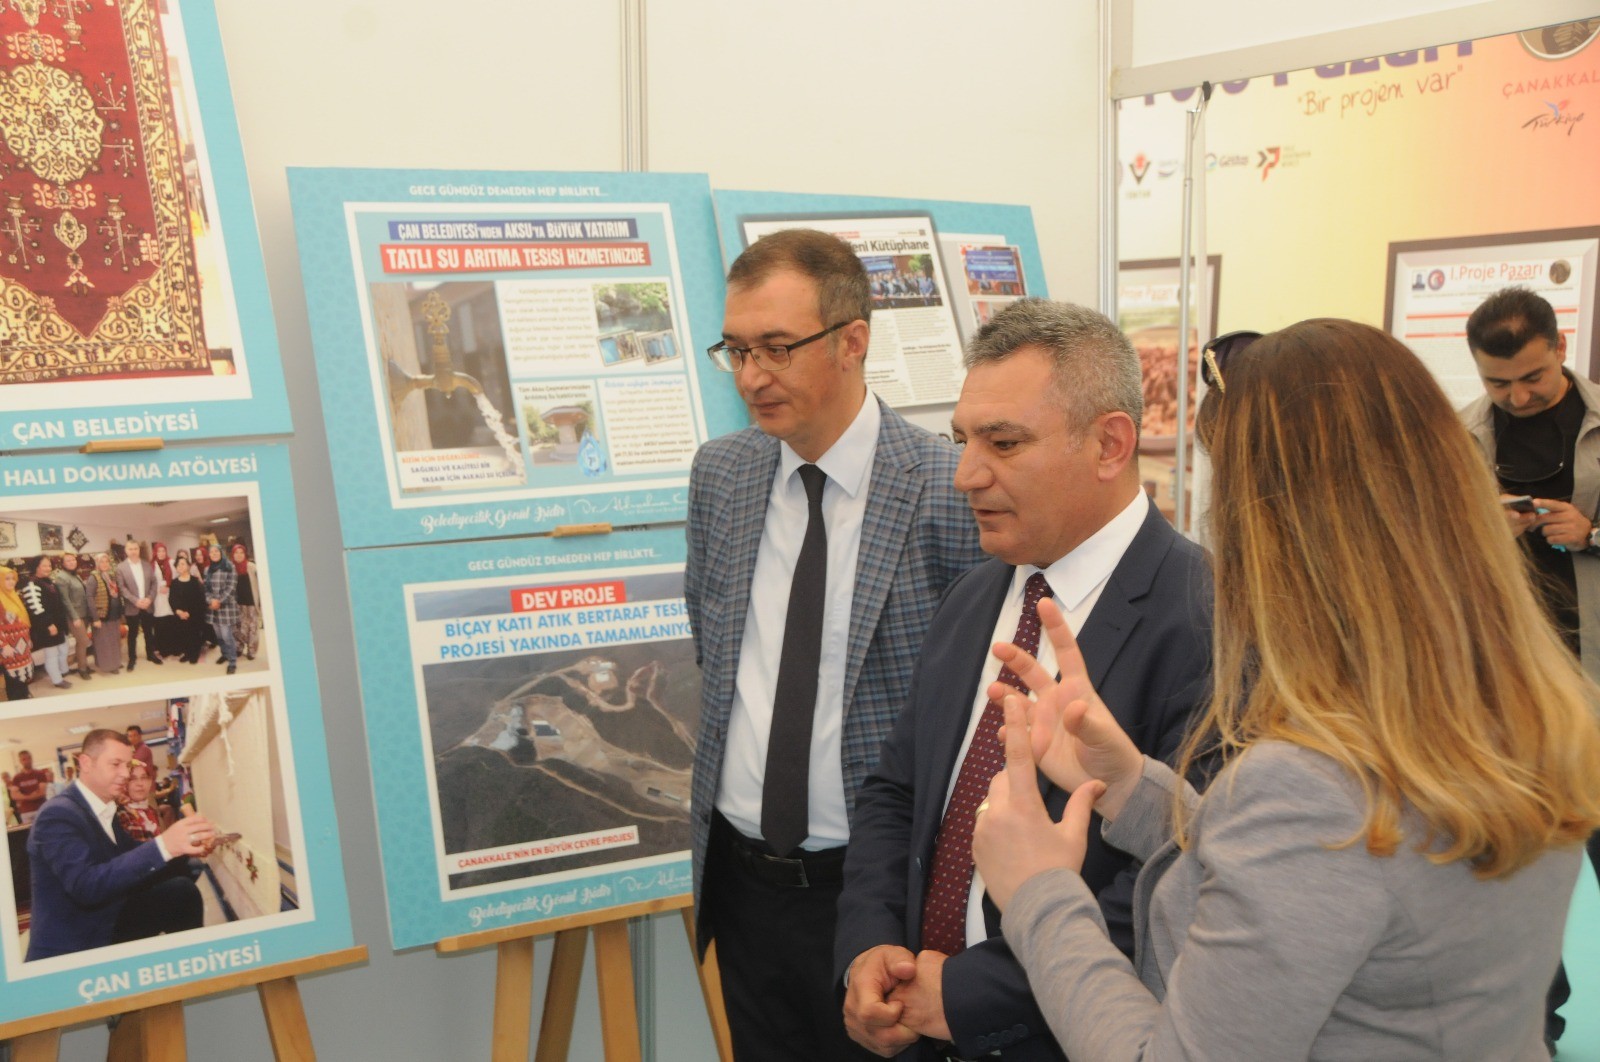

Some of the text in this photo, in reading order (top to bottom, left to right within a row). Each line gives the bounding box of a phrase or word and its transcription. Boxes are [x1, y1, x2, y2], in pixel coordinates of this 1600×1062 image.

[1341, 81, 1404, 118] projem
[410, 185, 436, 196] GECE
[439, 185, 485, 196] GÜNDÜZ
[488, 186, 535, 196] DEMEDEN
[538, 186, 557, 196] HEP
[398, 224, 420, 241] ÇAN
[547, 222, 583, 239] BÜYÜK
[584, 222, 630, 238] YATIRIM
[387, 246, 646, 270] TATLI SU ARITMA TESİSİ HİZMETİNİZDE
[871, 240, 929, 253] Kütüphane
[1500, 263, 1543, 279] Pazarı
[12, 408, 199, 445] ÇAN BELEDİYESİ
[4, 453, 258, 487] HALI DOKUMA ATÖLYESİ
[442, 463, 451, 471] VE
[468, 559, 495, 572] GECE
[497, 556, 542, 570] GÜNDÜZ
[545, 552, 592, 566] DEMEDEN
[594, 551, 612, 562] HEP
[522, 586, 616, 610] DEV PROJE
[445, 618, 492, 641] BİÇAY
[497, 615, 533, 633] KATI
[537, 613, 571, 630] ATIK
[578, 604, 650, 627] BERTARAF
[441, 637, 506, 660] PROJESİ
[509, 634, 583, 653] YAKINDA
[531, 846, 542, 858] EN
[544, 840, 574, 856] BÜYÜK
[602, 831, 635, 846] PROJESİ
[78, 940, 262, 1003] ÇAN BELEDİYESİ
